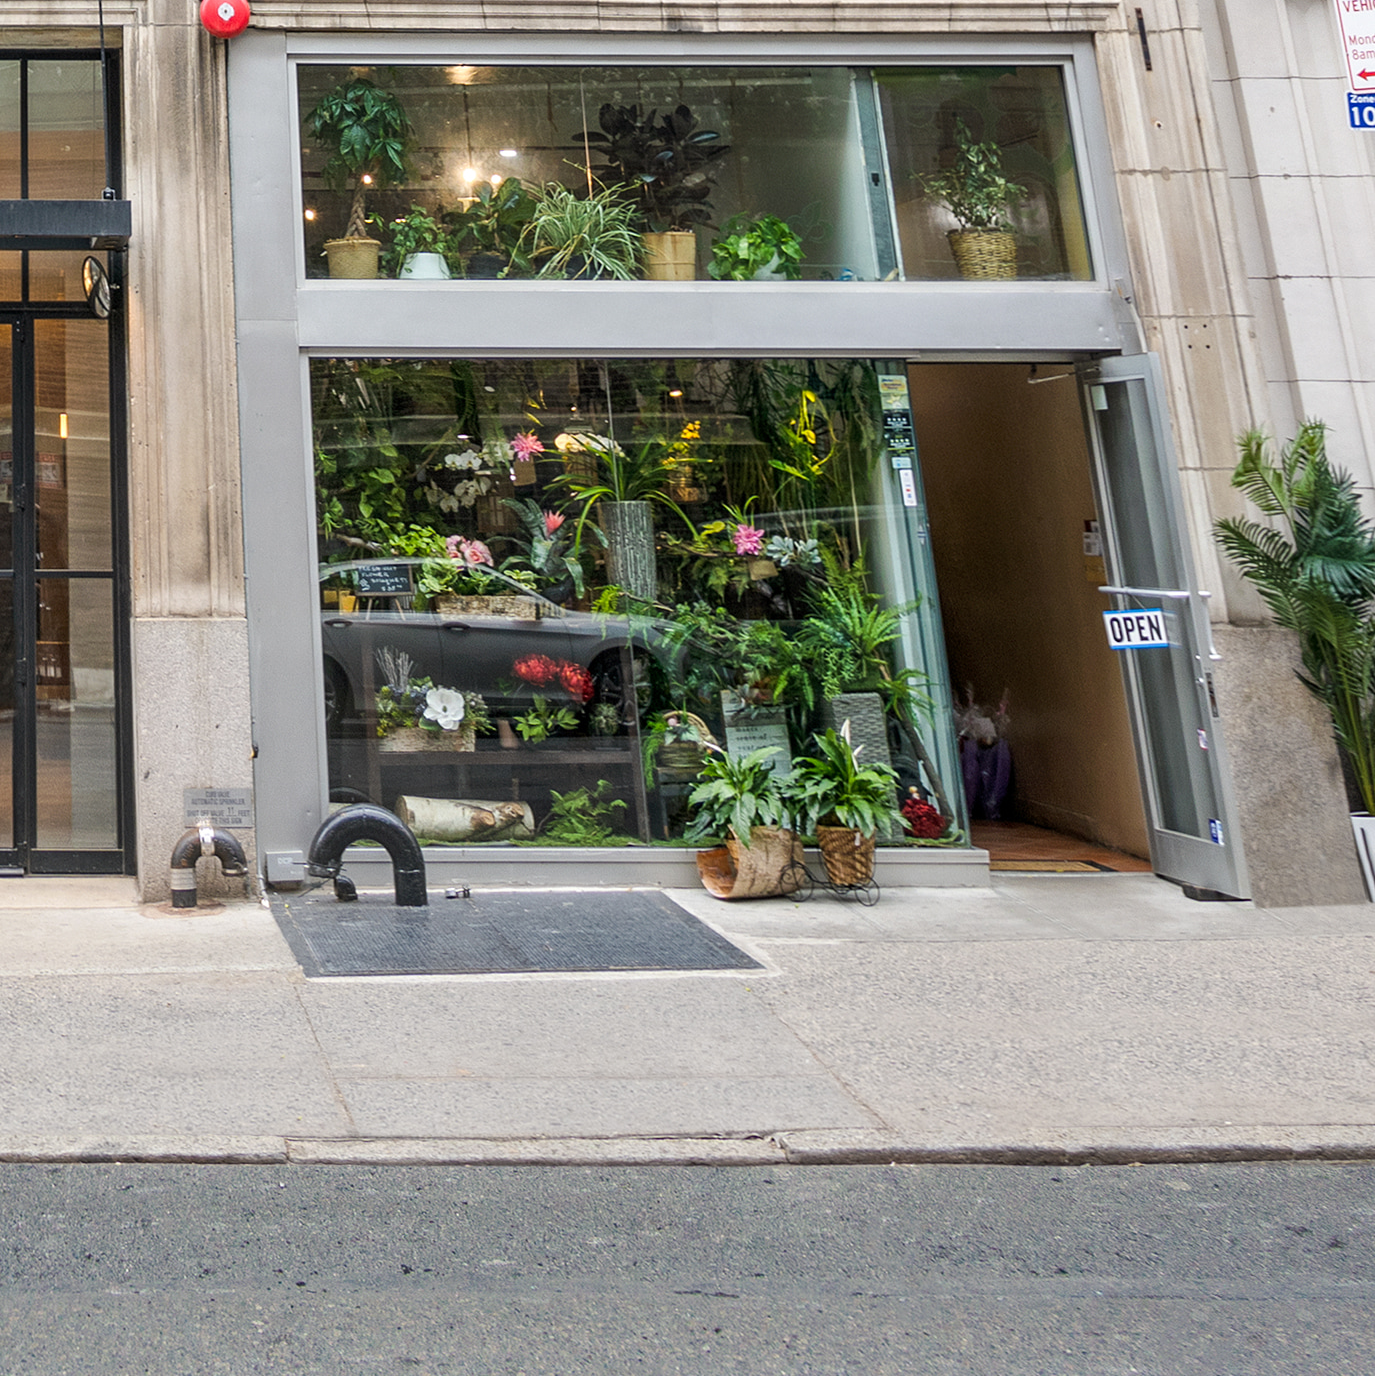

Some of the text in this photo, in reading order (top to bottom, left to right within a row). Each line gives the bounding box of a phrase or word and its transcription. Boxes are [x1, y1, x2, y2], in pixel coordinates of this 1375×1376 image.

[1352, 49, 1375, 61] 8am
[1350, 94, 1375, 103] Zone
[1109, 614, 1163, 643] OPEN
